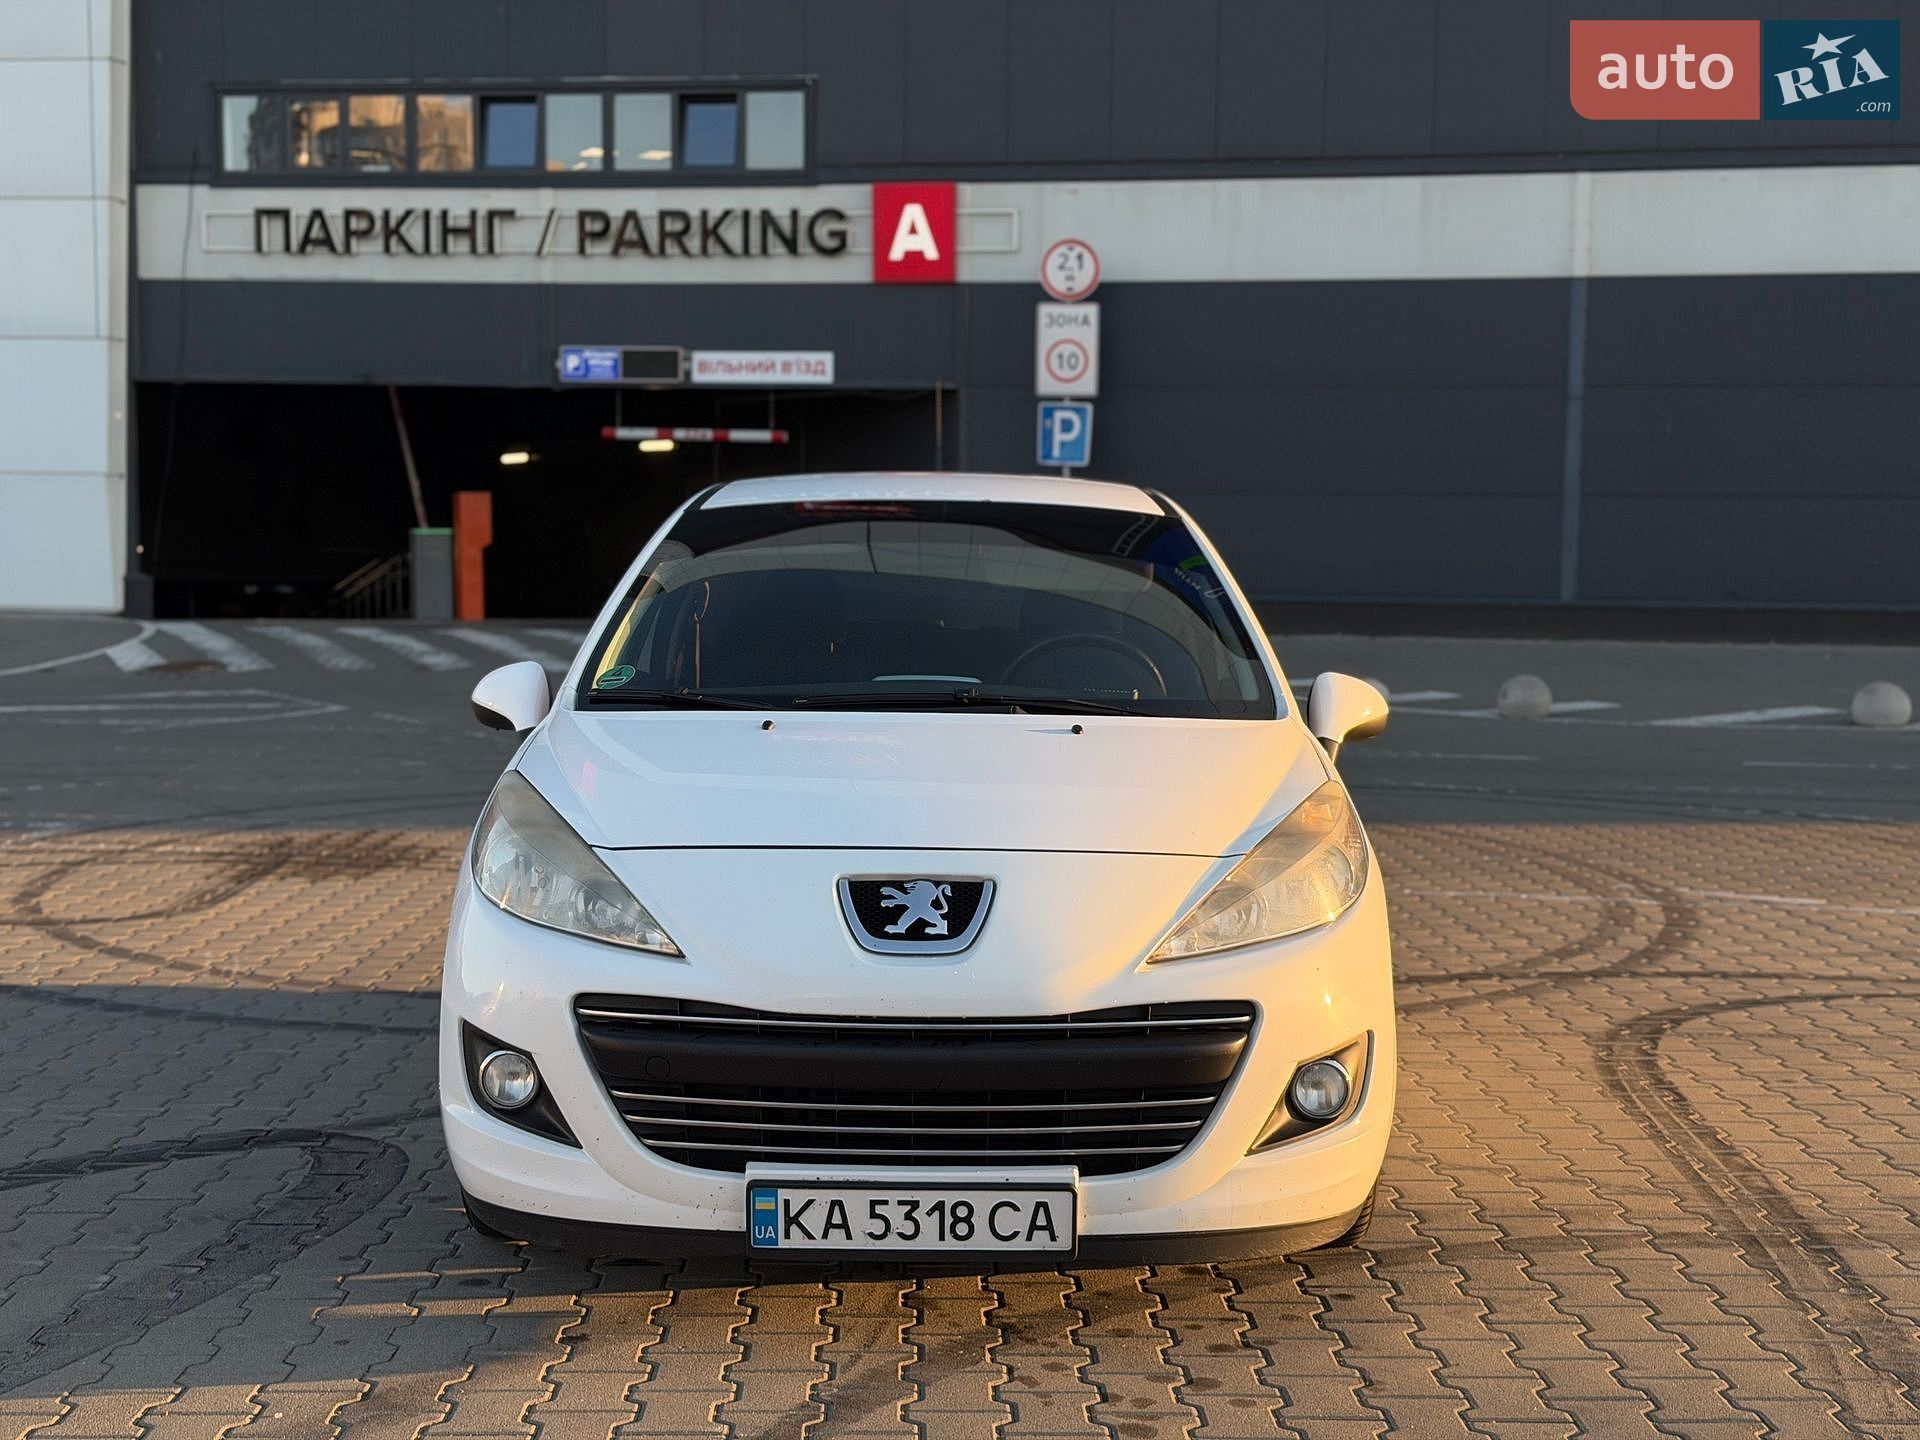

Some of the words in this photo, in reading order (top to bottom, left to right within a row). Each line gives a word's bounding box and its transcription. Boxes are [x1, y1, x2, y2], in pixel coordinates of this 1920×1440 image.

[254, 208, 516, 255] ПАРКІНГ
[576, 208, 849, 257] PARKING
[887, 202, 940, 262] A
[1045, 313, 1091, 328] ЗОНА
[1056, 352, 1080, 371] 10
[1052, 409, 1082, 458] P
[755, 1225, 776, 1239] UA
[783, 1198, 853, 1241] KA
[867, 1199, 975, 1242] 5318
[988, 1201, 1058, 1242] CA
